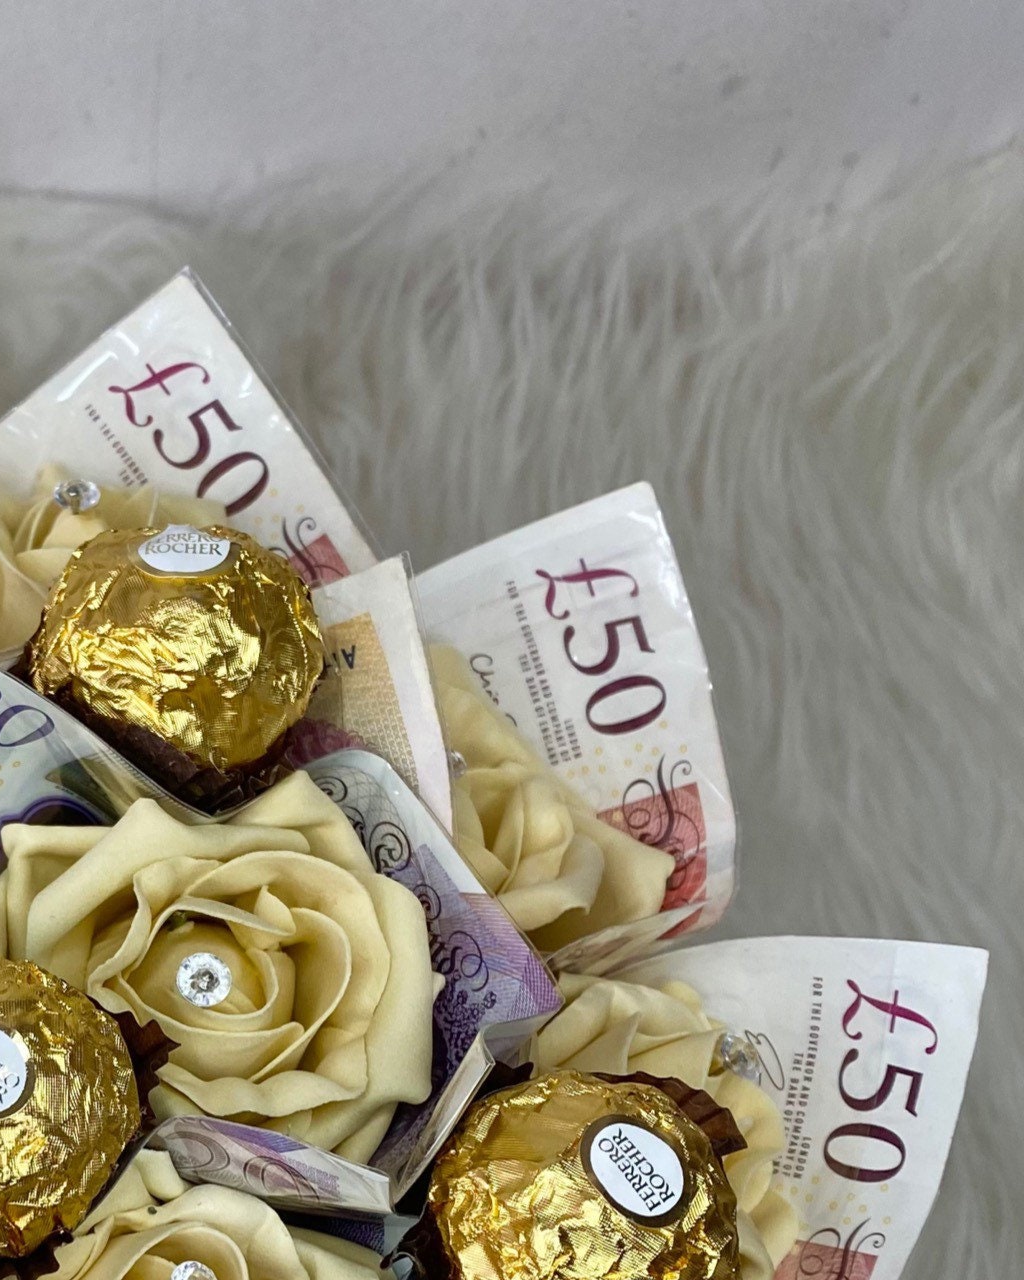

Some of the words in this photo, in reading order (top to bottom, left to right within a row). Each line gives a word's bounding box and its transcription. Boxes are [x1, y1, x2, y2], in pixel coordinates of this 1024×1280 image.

[144, 542, 223, 556] ROCHER
[535, 557, 667, 736] £50
[812, 976, 824, 997] FOR
[811, 1002, 823, 1021] THE
[792, 1052, 804, 1072] THE
[803, 1025, 821, 1082] GOVERNOR
[785, 1077, 800, 1108] BANK
[798, 1085, 811, 1108] AND
[823, 978, 938, 1183] £50
[785, 1110, 806, 1162] COMPANY
[598, 1138, 662, 1212] FERRERO
[613, 1127, 676, 1203] ROCHER
[782, 1162, 793, 1178] OF
[793, 1135, 812, 1180] LONDON
